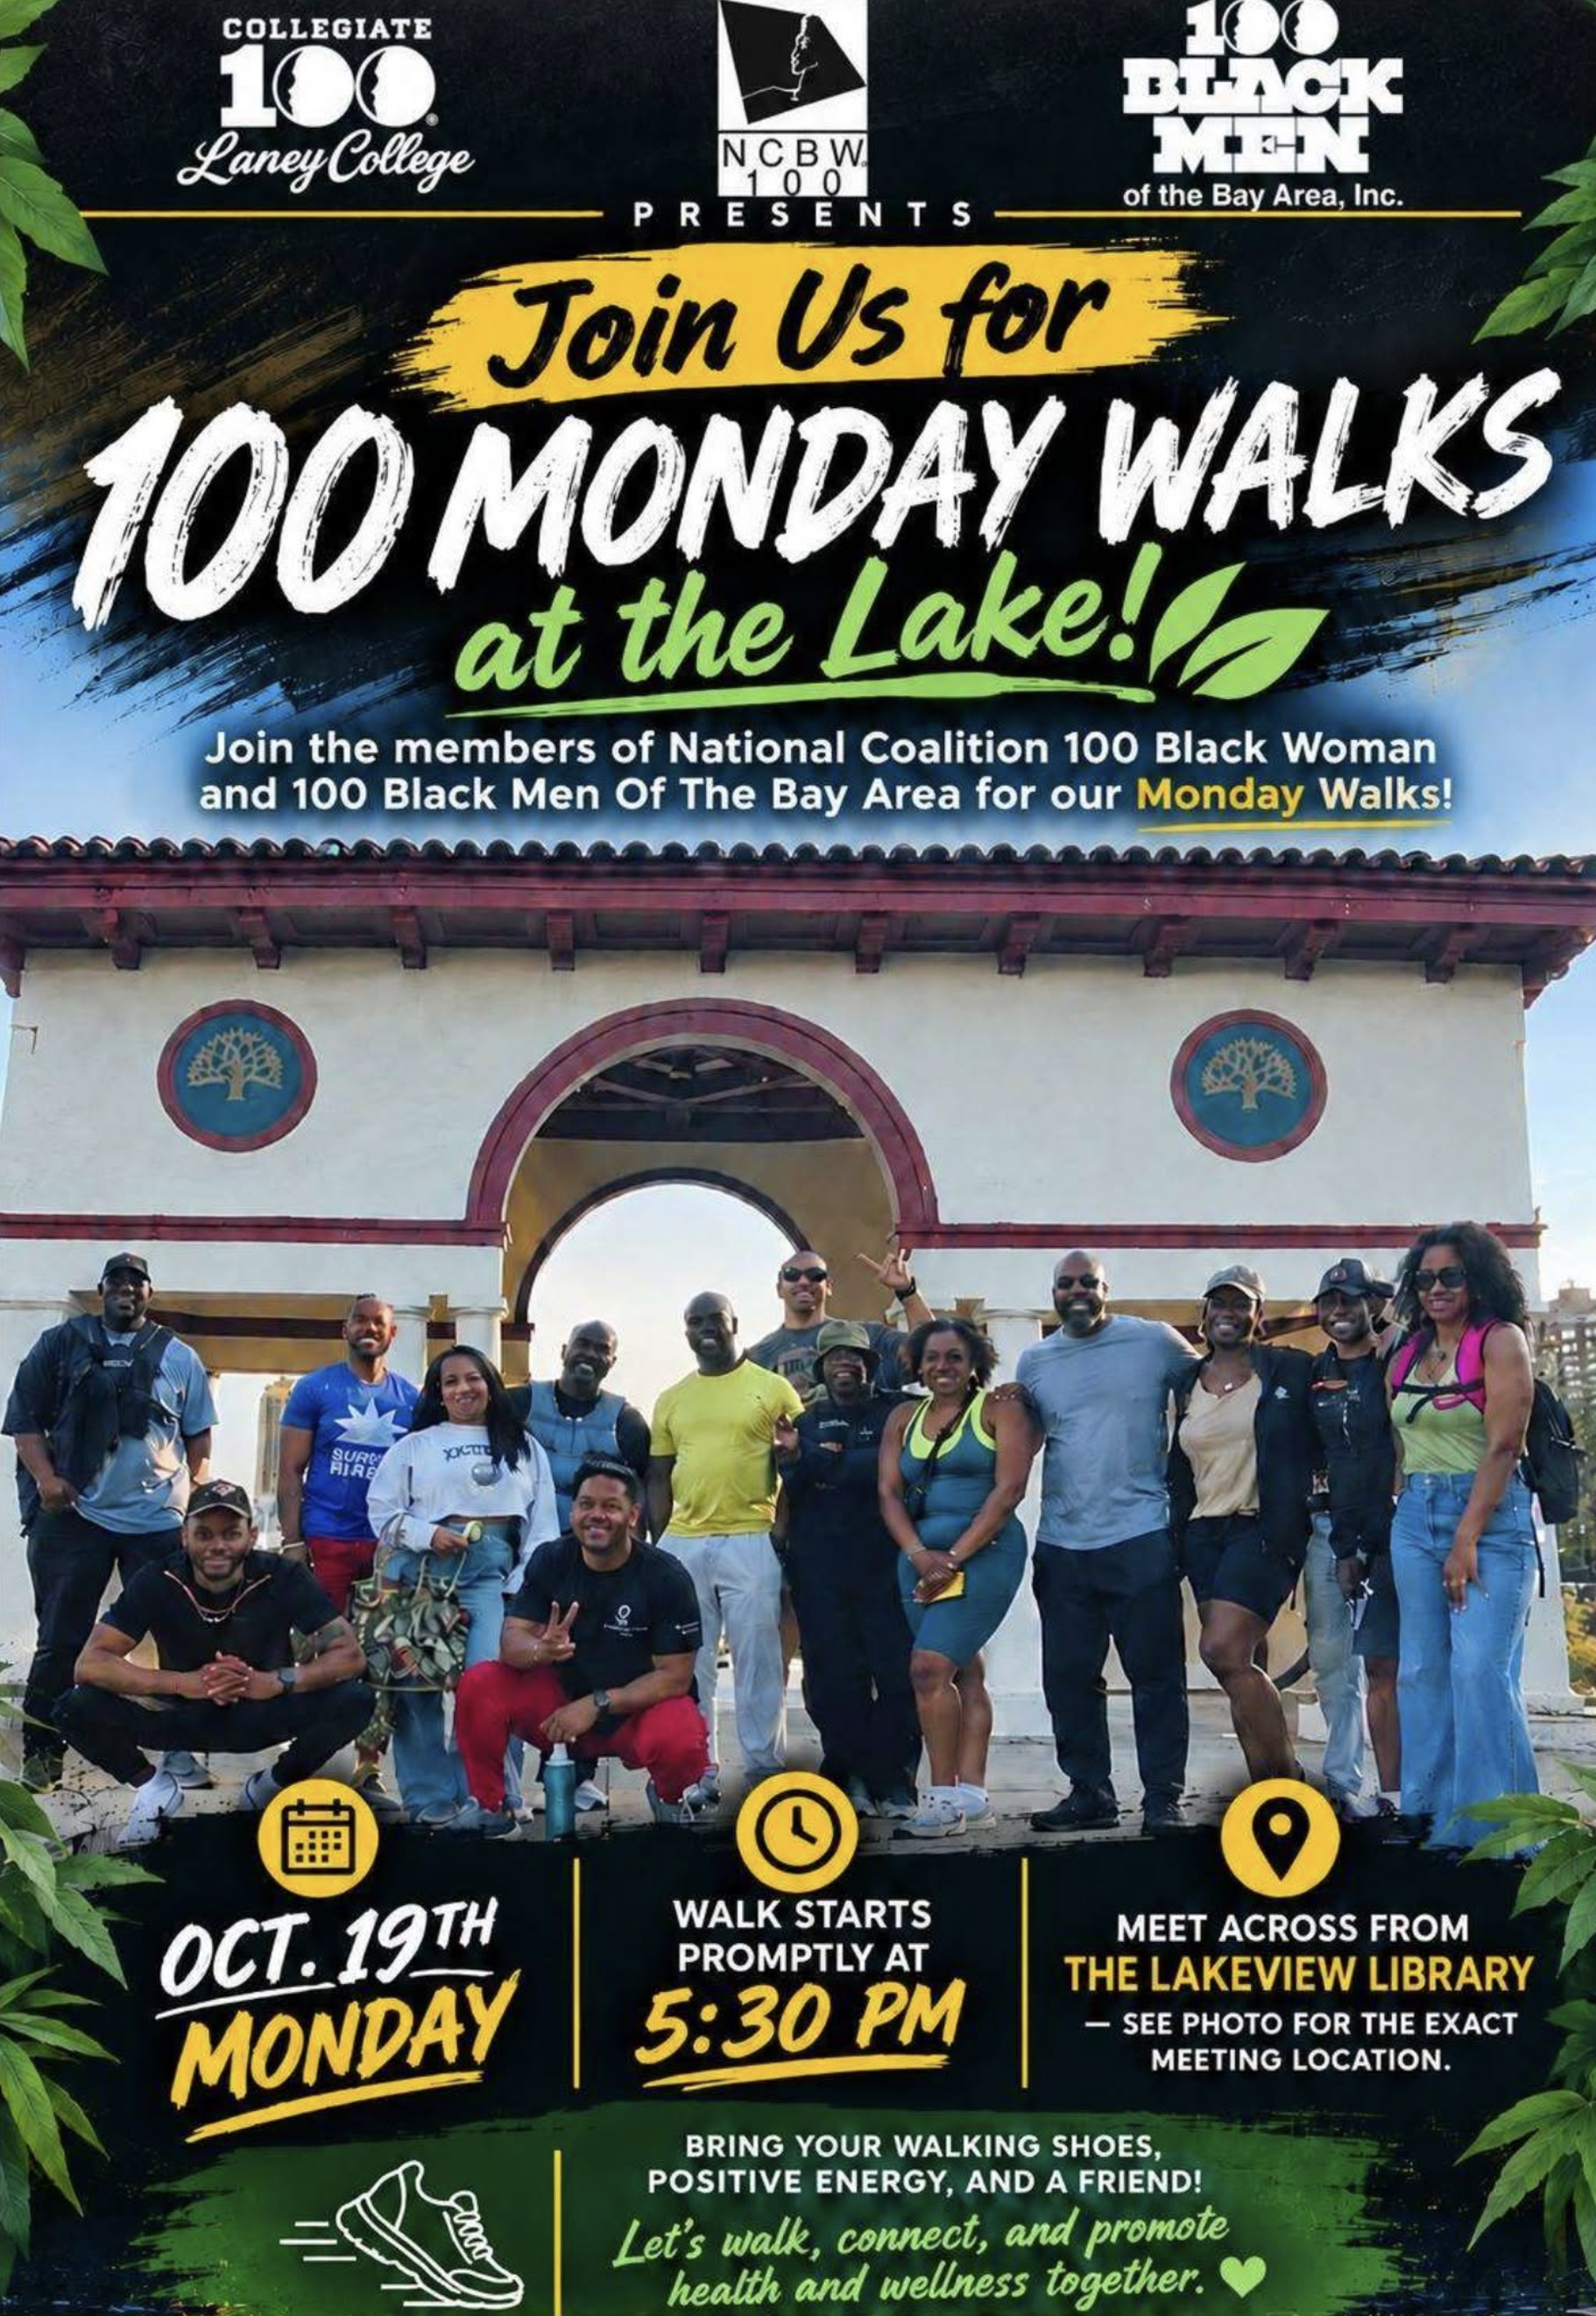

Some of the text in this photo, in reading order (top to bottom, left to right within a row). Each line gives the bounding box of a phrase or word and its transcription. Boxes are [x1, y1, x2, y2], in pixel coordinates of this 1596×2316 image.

[222, 18, 432, 39] COLLEGIATE
[1186, 0, 1339, 56] 100
[220, 44, 436, 128] 100
[1123, 58, 1403, 114] BLACK
[177, 129, 476, 194] Laney College
[1153, 116, 1369, 173] MEN
[634, 201, 971, 227] PRESENTS
[1123, 183, 1403, 211] of the Bay Area, Inc.
[487, 261, 1111, 389] Join Us for
[71, 367, 1562, 632] 100 MONDAY WALKS
[455, 540, 1163, 691] at the Lake!
[205, 730, 1436, 764] Join the members of National Coalition 100 Black Woman
[200, 775, 1451, 818] and 100 Black Men Of The Bay Area for our Monday Walks!
[673, 1899, 931, 1929] WALK STARTS
[1118, 1914, 1468, 1942] MEET ACROSS FROM
[159, 1911, 316, 1997] OCT.
[679, 1943, 929, 1972] PROMPTLY AT
[1064, 1956, 1535, 1992] THE LAKEVIEW LIBRARY
[170, 1968, 522, 2110] MONDAY
[634, 1978, 966, 2066] 5:30 PM
[1123, 2012, 1172, 2035] SEE
[1183, 2012, 1282, 2035] PHOTO
[1294, 2012, 1351, 2035] FOR
[1361, 2012, 1415, 2035] THE
[1425, 2012, 1518, 2035] EXACT
[1152, 2048, 1451, 2071] MEETING LOCATION.
[687, 2134, 1162, 2161] BRING YOUR WALKING SHOES,
[648, 2169, 1201, 2198] POSITIVE ENERGY, AND A FRIEND!
[611, 2205, 1231, 2268] Let's walk, connect, and promote
[667, 2256, 1204, 2312] health and wellness together.
